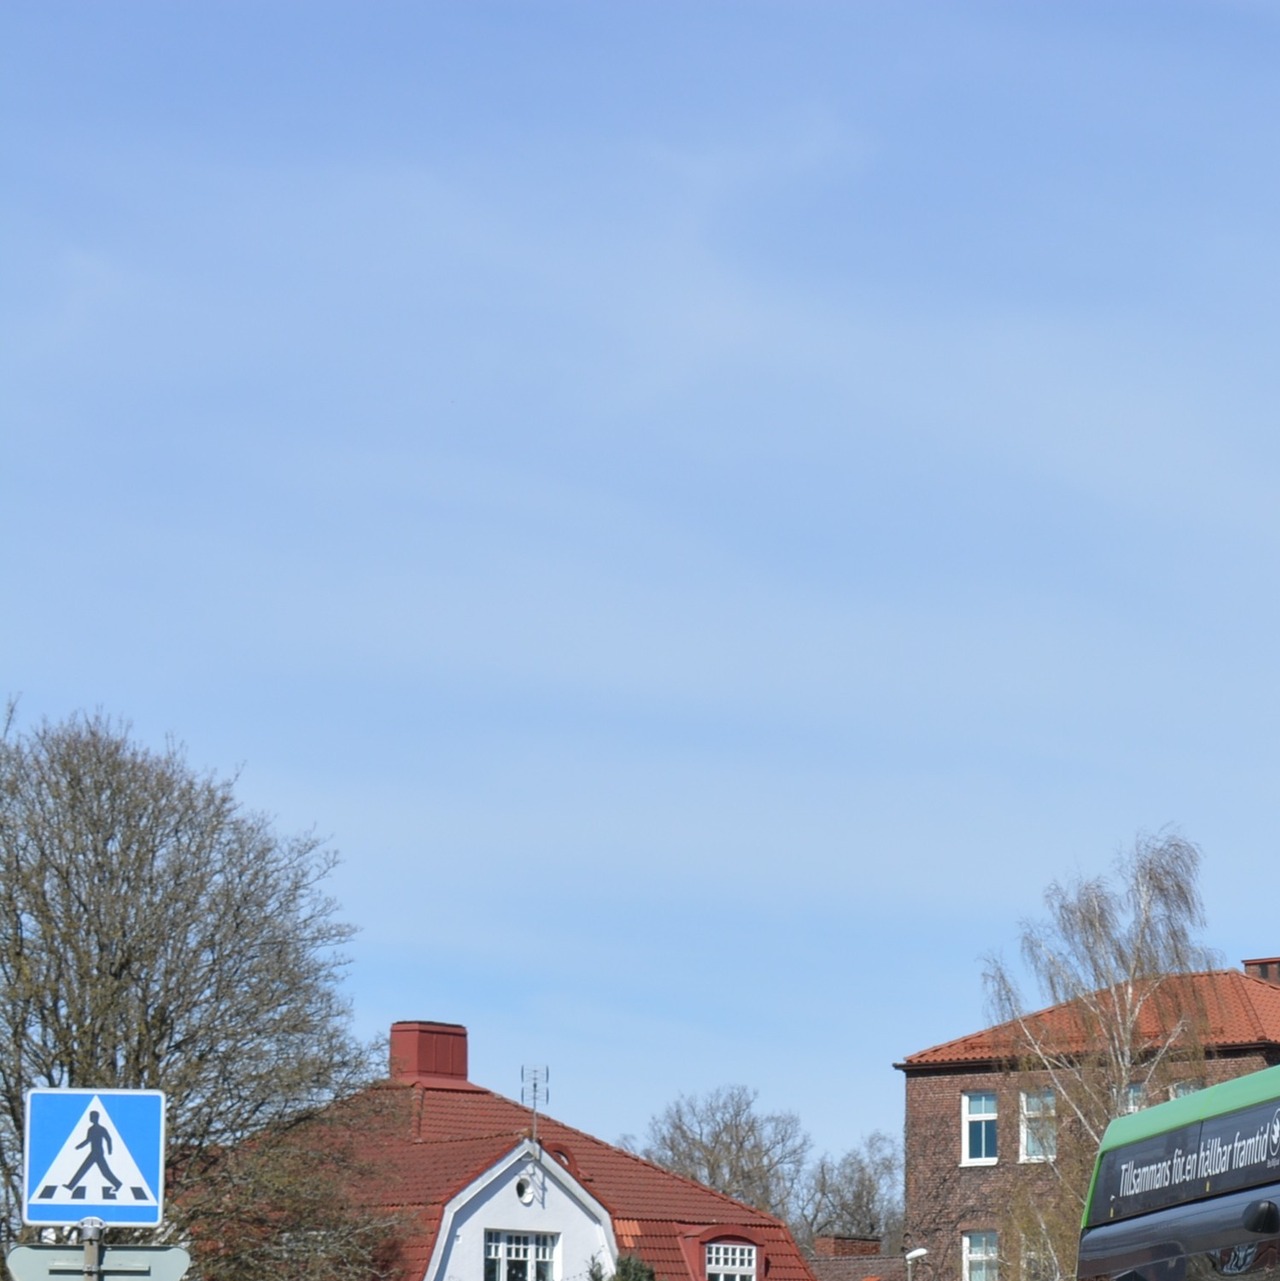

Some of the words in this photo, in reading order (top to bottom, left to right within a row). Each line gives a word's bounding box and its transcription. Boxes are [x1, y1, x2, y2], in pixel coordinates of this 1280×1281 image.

[1119, 1159, 1171, 1198] Tillsammans
[1171, 1149, 1185, 1185] för
[1185, 1153, 1197, 1182] en
[1197, 1137, 1231, 1178] hållbar
[1232, 1122, 1270, 1170] framtid
